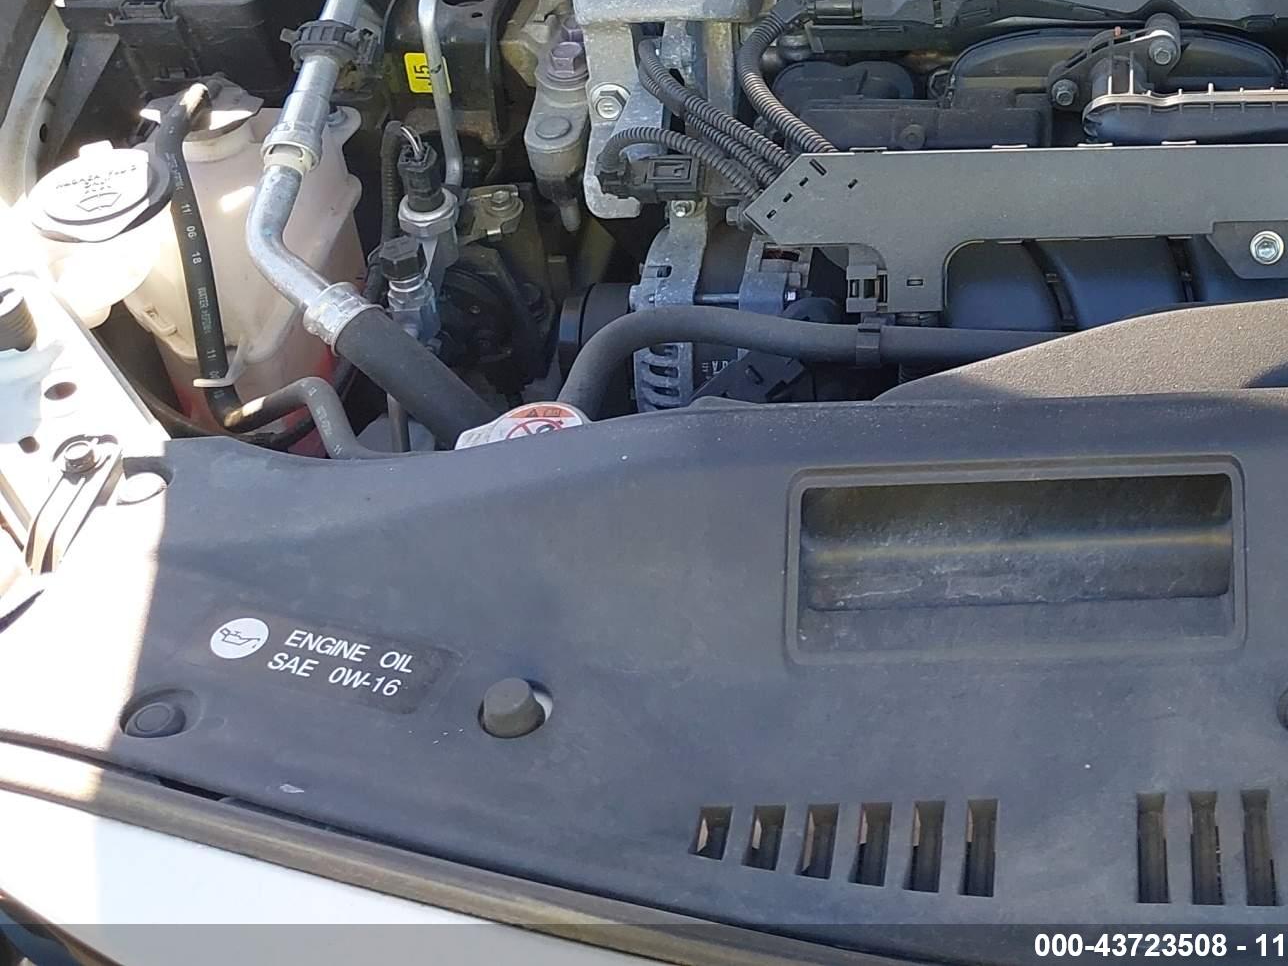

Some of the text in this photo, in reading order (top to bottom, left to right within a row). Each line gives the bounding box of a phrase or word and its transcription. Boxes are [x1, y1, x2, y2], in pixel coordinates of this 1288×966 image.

[284, 629, 413, 674] ENGINE OIL
[267, 652, 402, 697] SAE 0W-16
